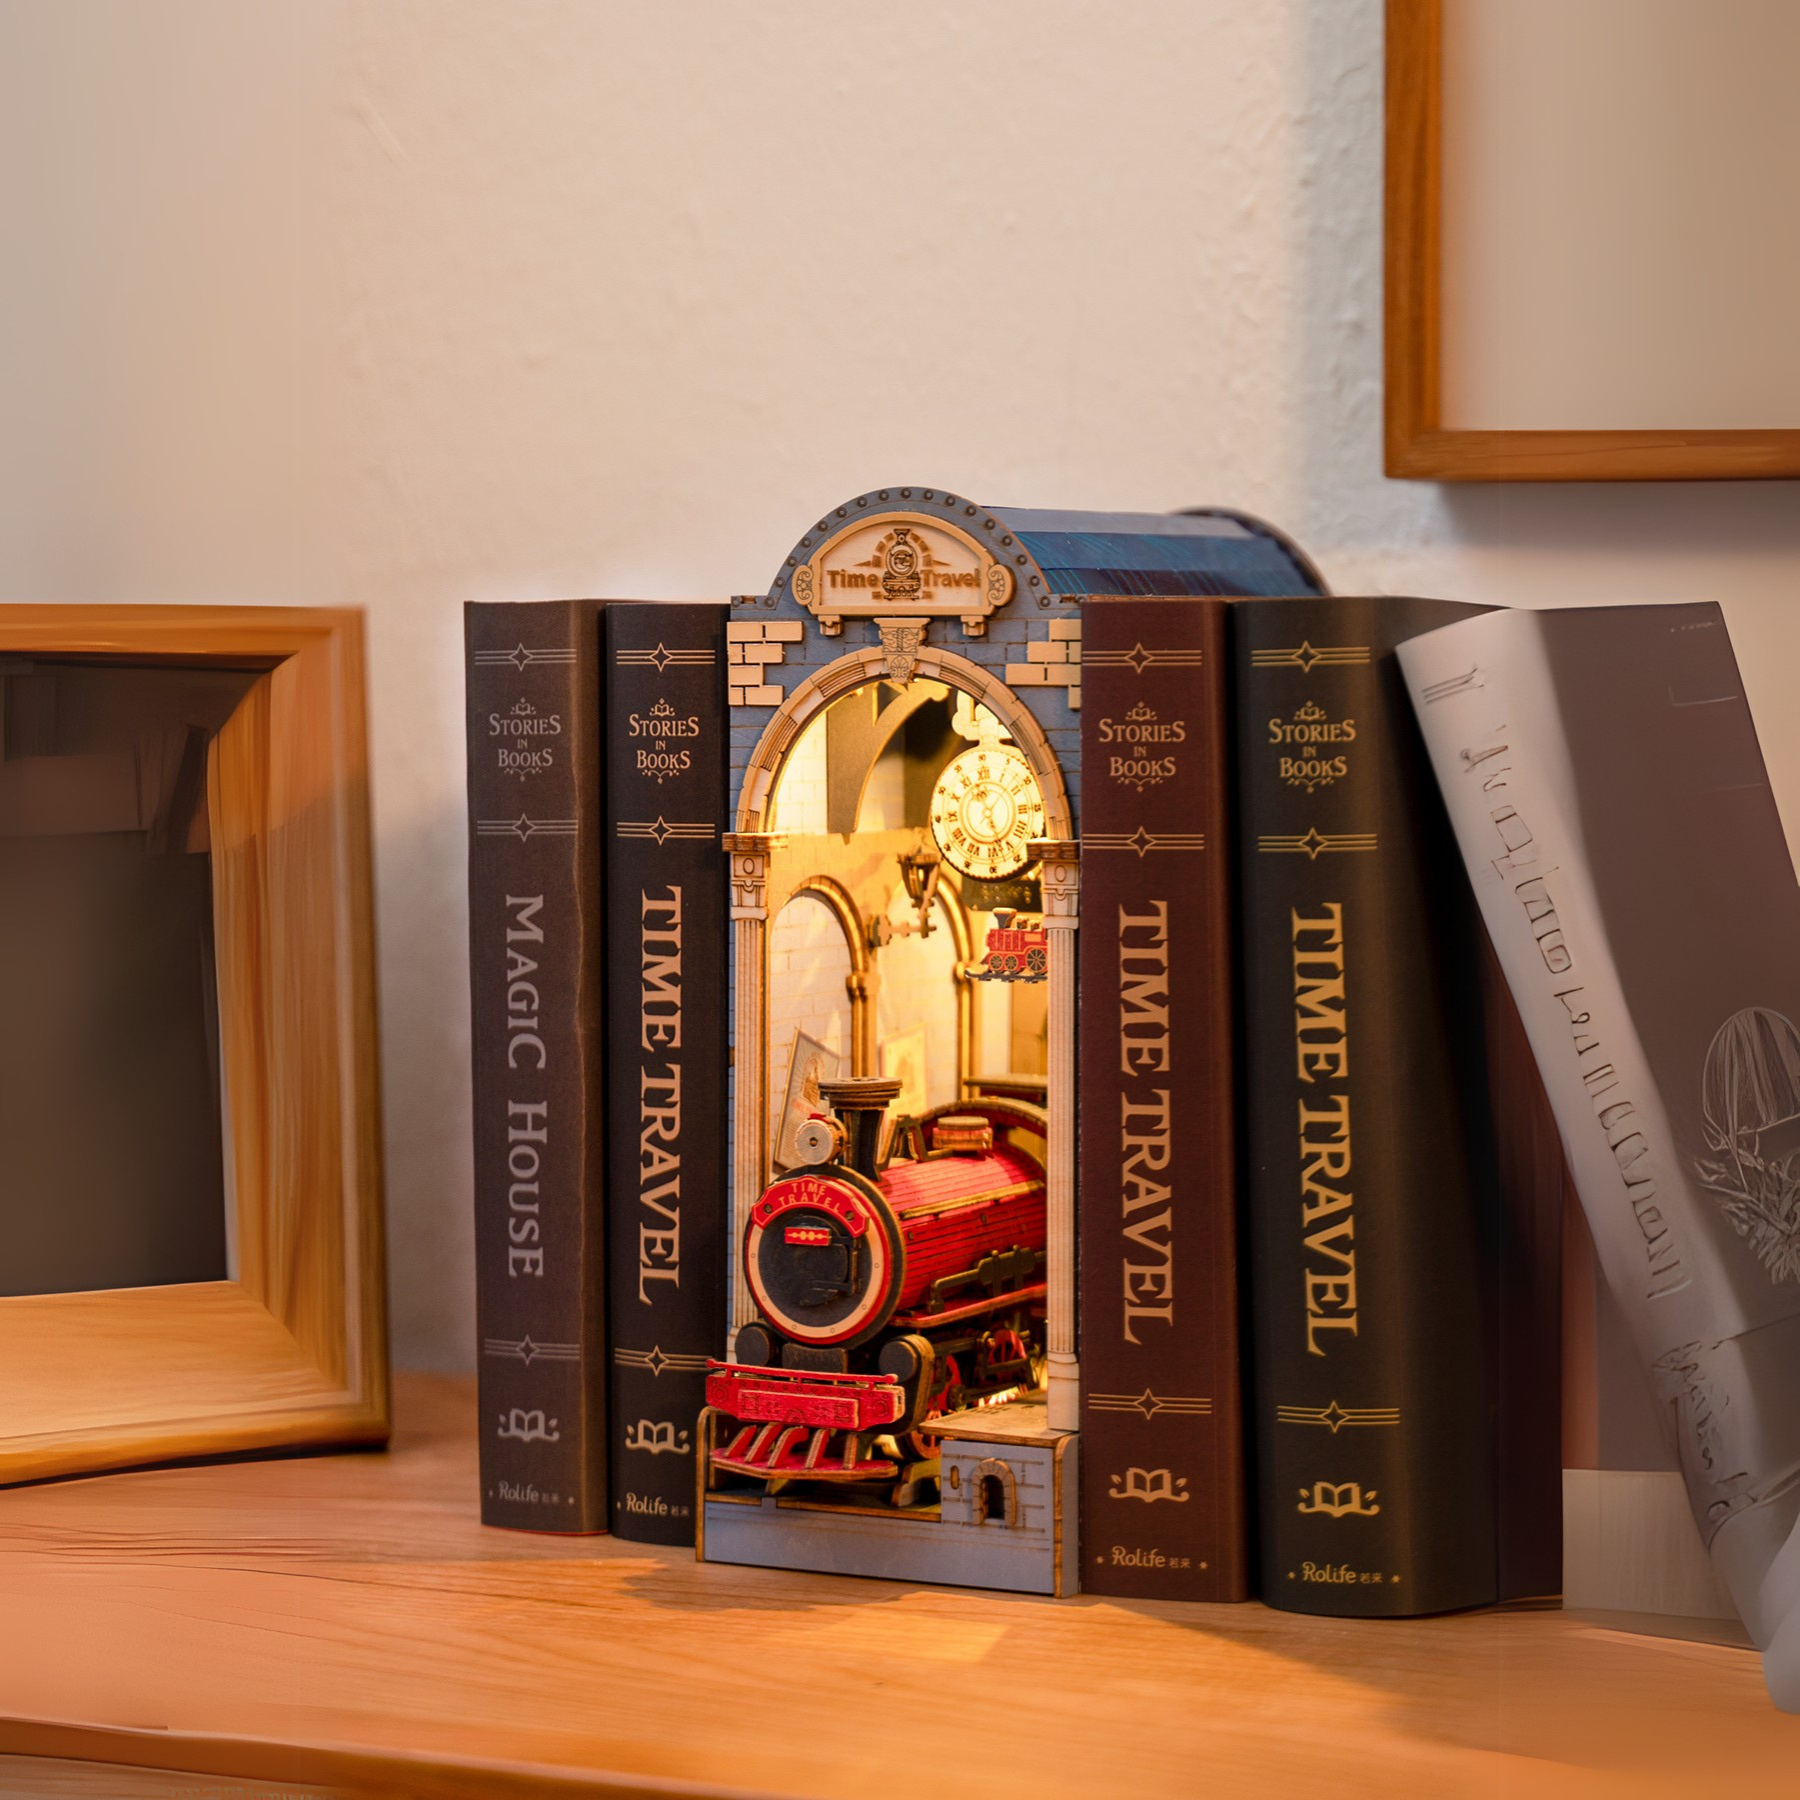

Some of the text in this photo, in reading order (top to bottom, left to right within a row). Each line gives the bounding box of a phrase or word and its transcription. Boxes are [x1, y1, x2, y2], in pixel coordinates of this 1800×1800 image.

[826, 568, 981, 589] Time Travel
[489, 713, 562, 736] STORIES
[629, 713, 700, 737] STORIES
[1098, 718, 1186, 743] STORIES
[1268, 718, 1357, 744] STORIES
[517, 738, 528, 749] IN
[655, 740, 666, 750] IN
[1133, 745, 1147, 757] IN
[1303, 746, 1316, 757] IN
[498, 748, 553, 767] BOOKS
[636, 750, 691, 769] BOOKS
[1109, 757, 1176, 777] BOOKS
[1279, 756, 1348, 778] BOOKS
[960, 776, 972, 789] XI
[977, 768, 990, 780] XII
[1011, 785, 1021, 796] II
[1018, 804, 1027, 814] III
[505, 894, 547, 1278] MAGIC HOUSE
[639, 885, 682, 1306] TIME TRAVEL
[1119, 900, 1173, 1345] TIME TRAVEL
[1291, 902, 1358, 1357] TIME TRAVEL
[792, 1182, 826, 1195] TIME
[779, 1193, 840, 1213] TRAVEL
[498, 1480, 539, 1502] Rolife
[626, 1492, 668, 1516] Rolife
[1112, 1545, 1166, 1568] Rolife
[1302, 1561, 1356, 1584] Rolife
